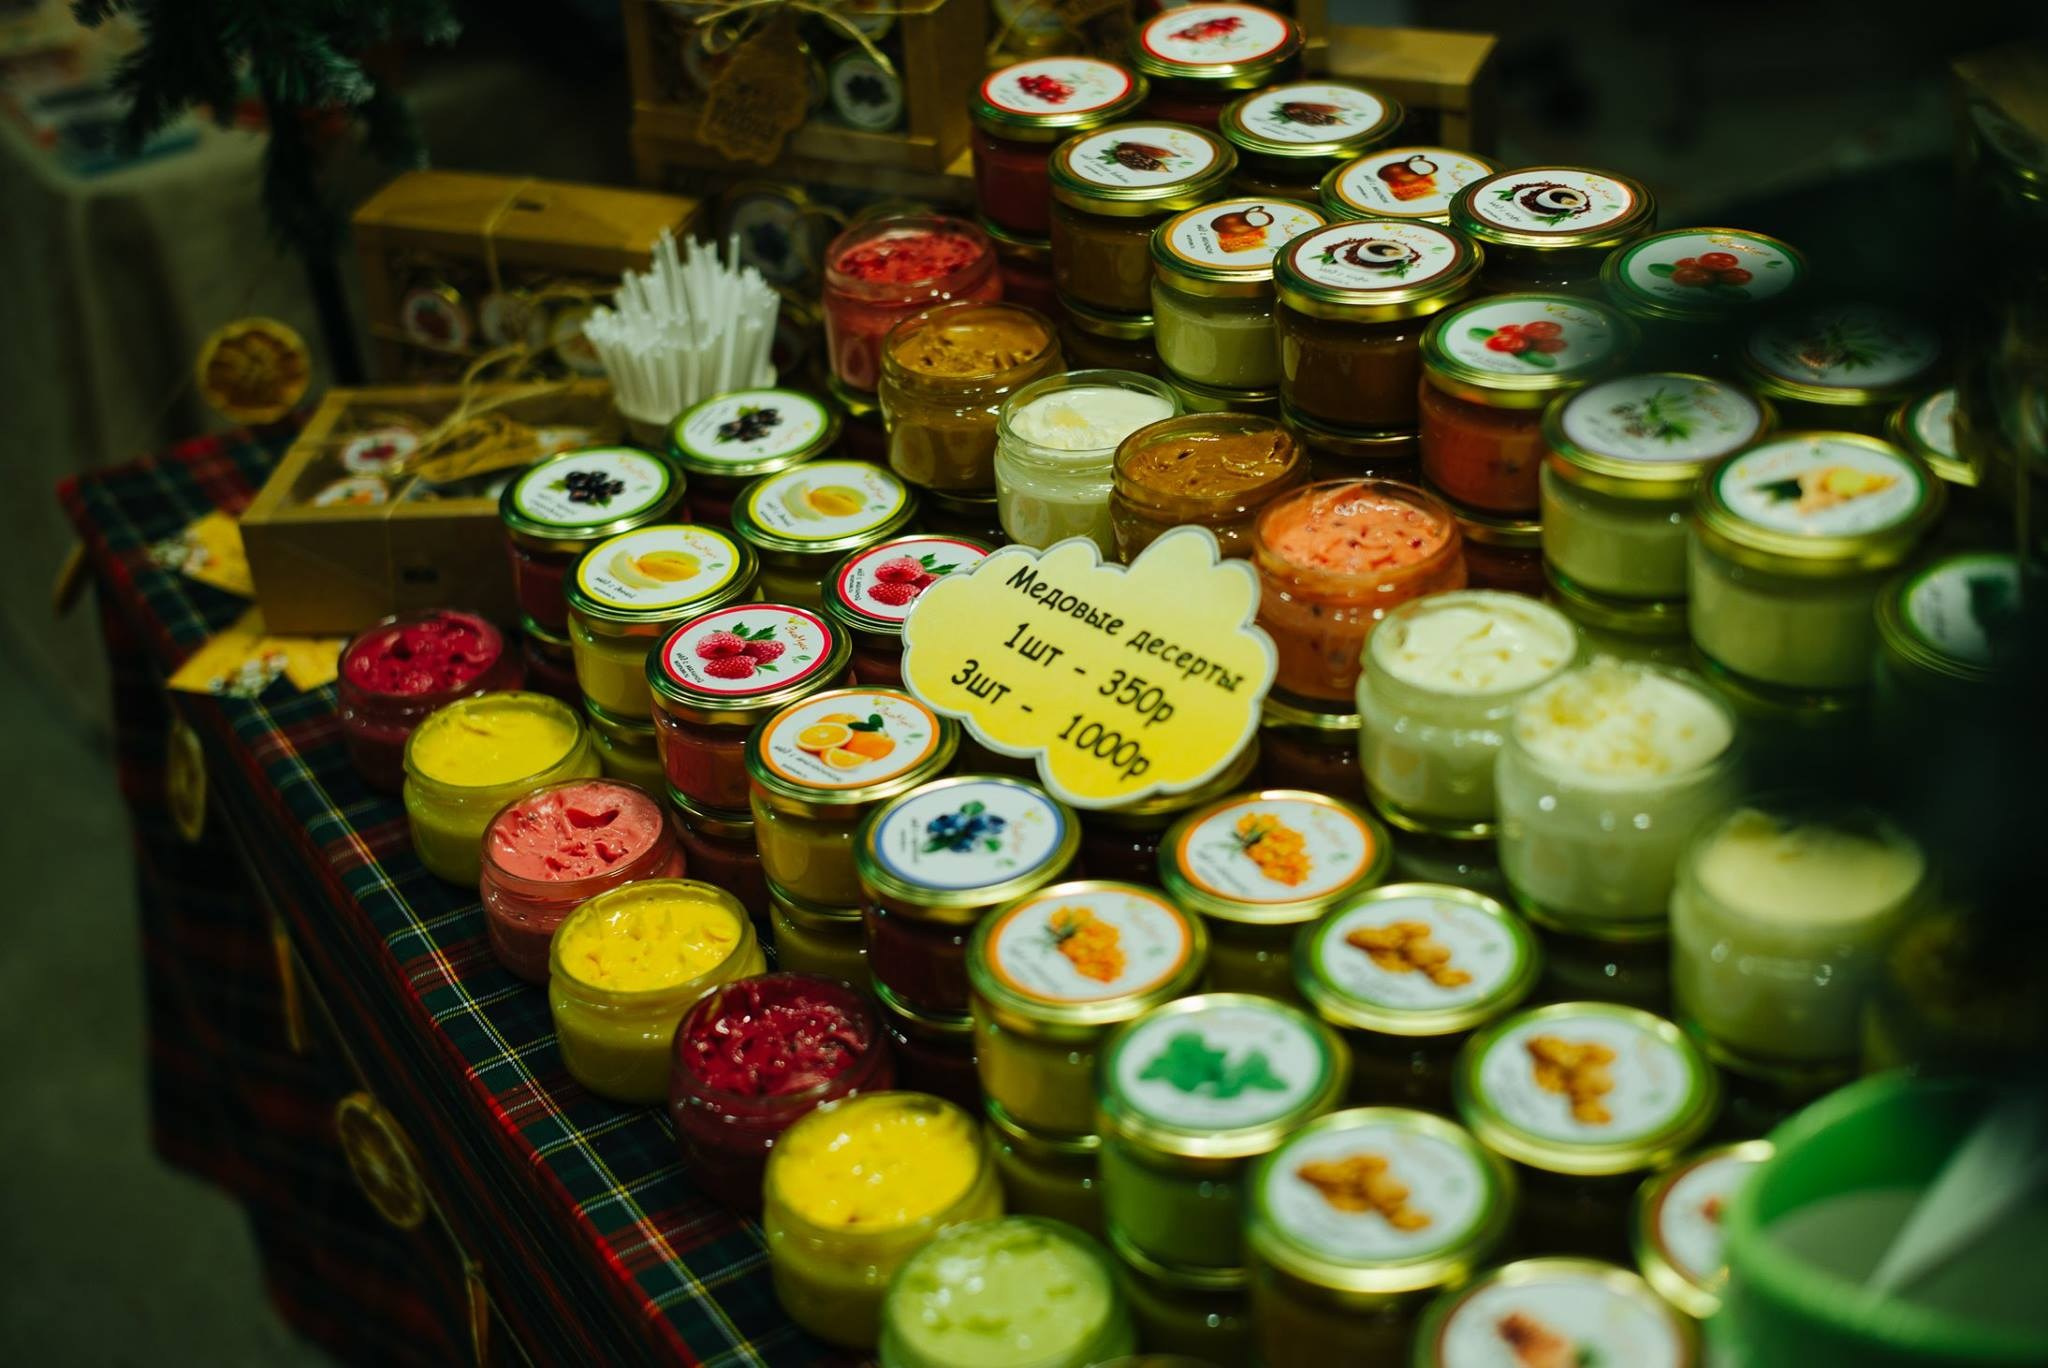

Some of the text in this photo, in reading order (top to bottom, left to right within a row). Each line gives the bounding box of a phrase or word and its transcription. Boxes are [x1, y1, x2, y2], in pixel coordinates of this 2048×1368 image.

[1004, 623, 1063, 666] 1шт
[1099, 670, 1174, 726] 350р
[1006, 566, 1243, 691] Медовые десерты
[952, 660, 1011, 704] 3шт
[1059, 715, 1149, 780] 1000р
